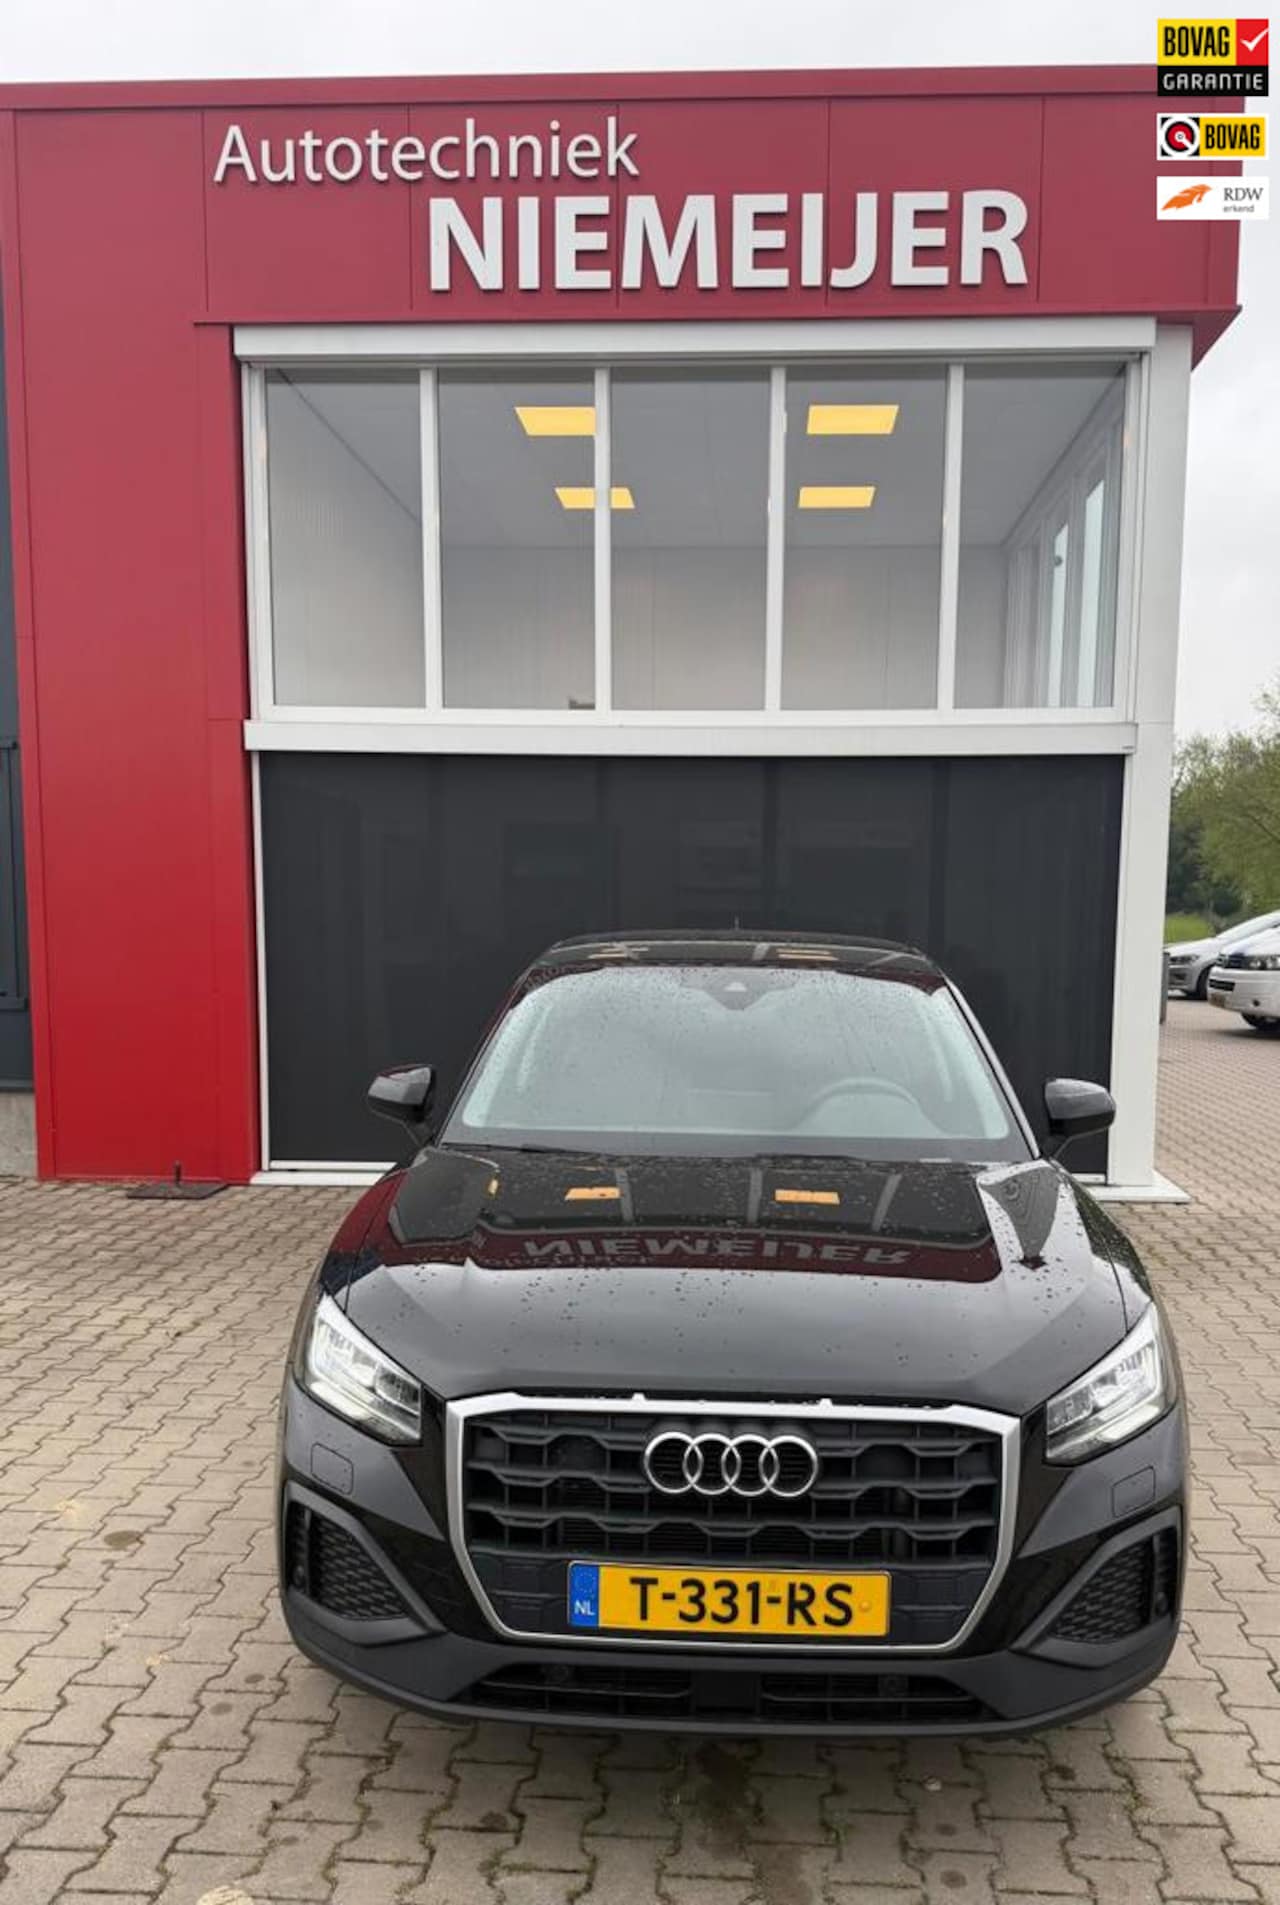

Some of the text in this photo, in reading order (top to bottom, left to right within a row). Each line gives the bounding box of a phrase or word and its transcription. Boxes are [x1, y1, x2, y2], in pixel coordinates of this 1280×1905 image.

[213, 116, 640, 184] Autotechniek
[428, 190, 1028, 291] NIEMEIJER
[574, 1600, 596, 1617] NL
[629, 1576, 854, 1628] T-331-RS
